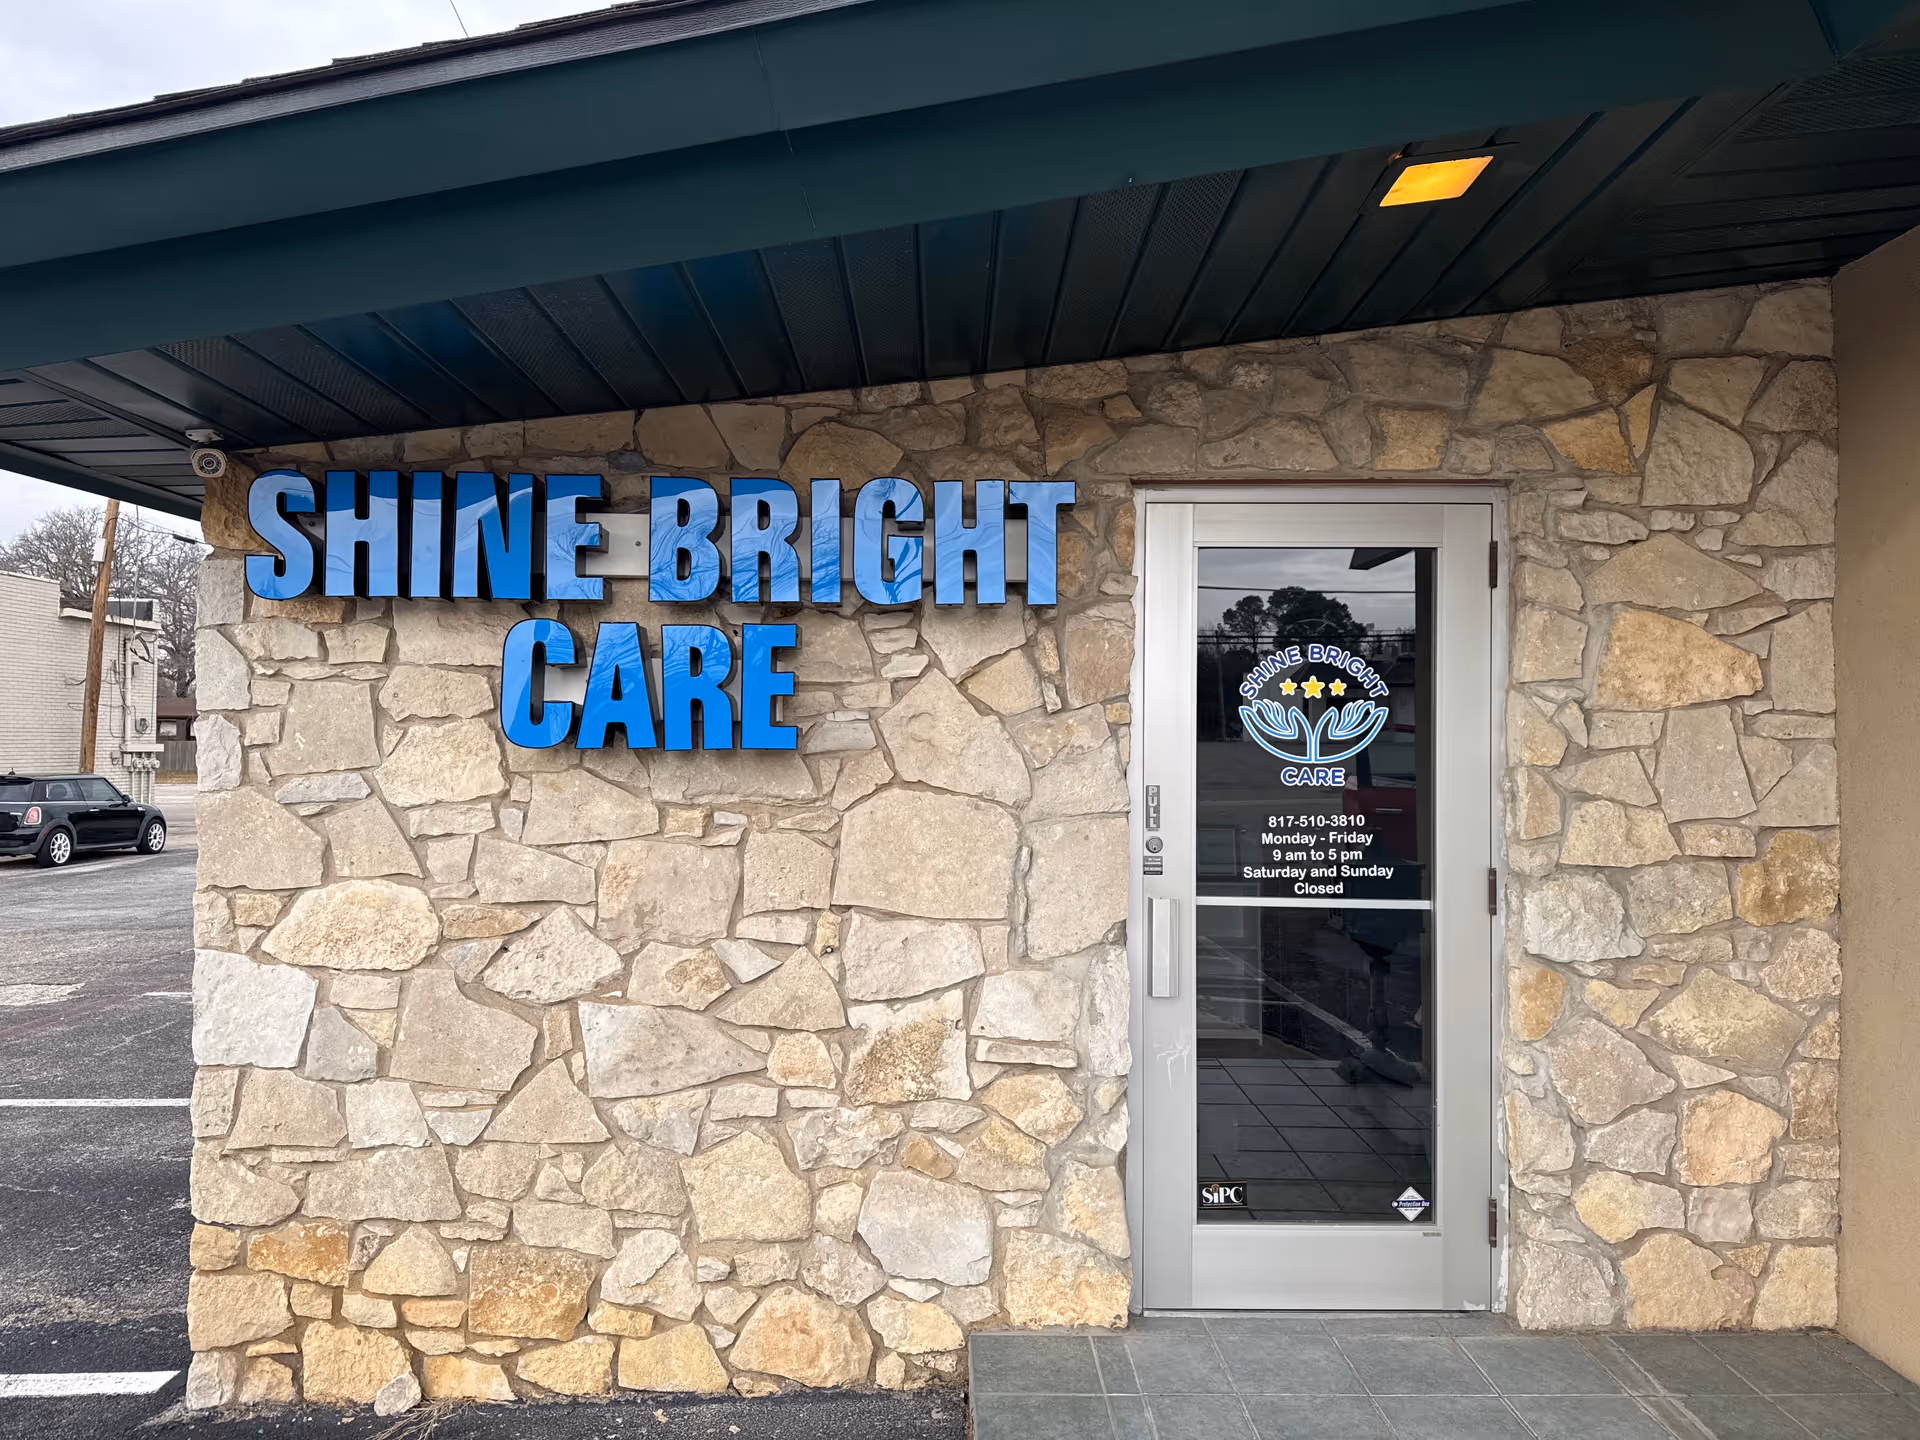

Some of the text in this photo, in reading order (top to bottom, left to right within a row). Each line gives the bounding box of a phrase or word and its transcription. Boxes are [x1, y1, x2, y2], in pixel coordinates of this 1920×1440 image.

[244, 469, 1077, 606] SHINE BRIGHT
[1239, 643, 1389, 700] SHINE BRIGHT
[500, 618, 798, 751] CARE
[1281, 766, 1345, 787] CARE
[1147, 785, 1158, 828] PULL
[1268, 814, 1366, 828] 817-510-3810
[1261, 832, 1317, 847] Monday
[1328, 831, 1374, 846] Friday
[1272, 848, 1363, 863] 9 am to 5 pm
[1243, 864, 1395, 880] Saturday and Sunday
[1294, 882, 1344, 895] Closed
